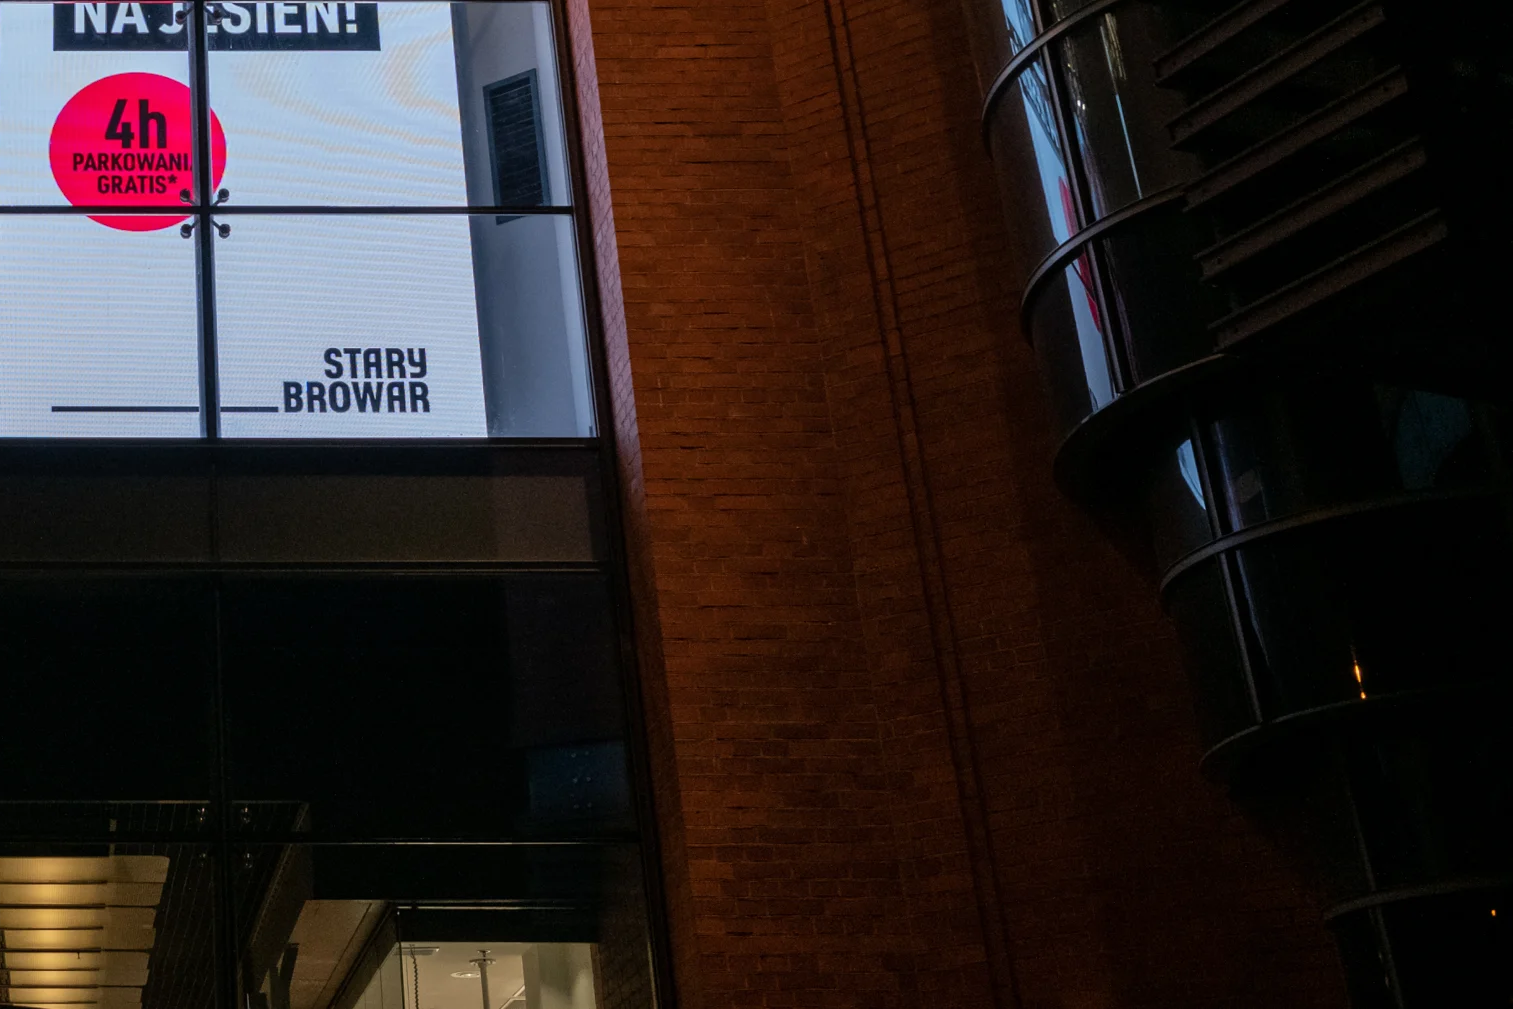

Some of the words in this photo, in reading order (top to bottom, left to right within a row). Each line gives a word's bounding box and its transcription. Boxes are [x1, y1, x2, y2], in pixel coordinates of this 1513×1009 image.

[104, 98, 168, 149] 4h
[72, 153, 193, 171] PARKOWANI
[324, 347, 428, 379] STARY
[283, 381, 431, 413] BROWAR
